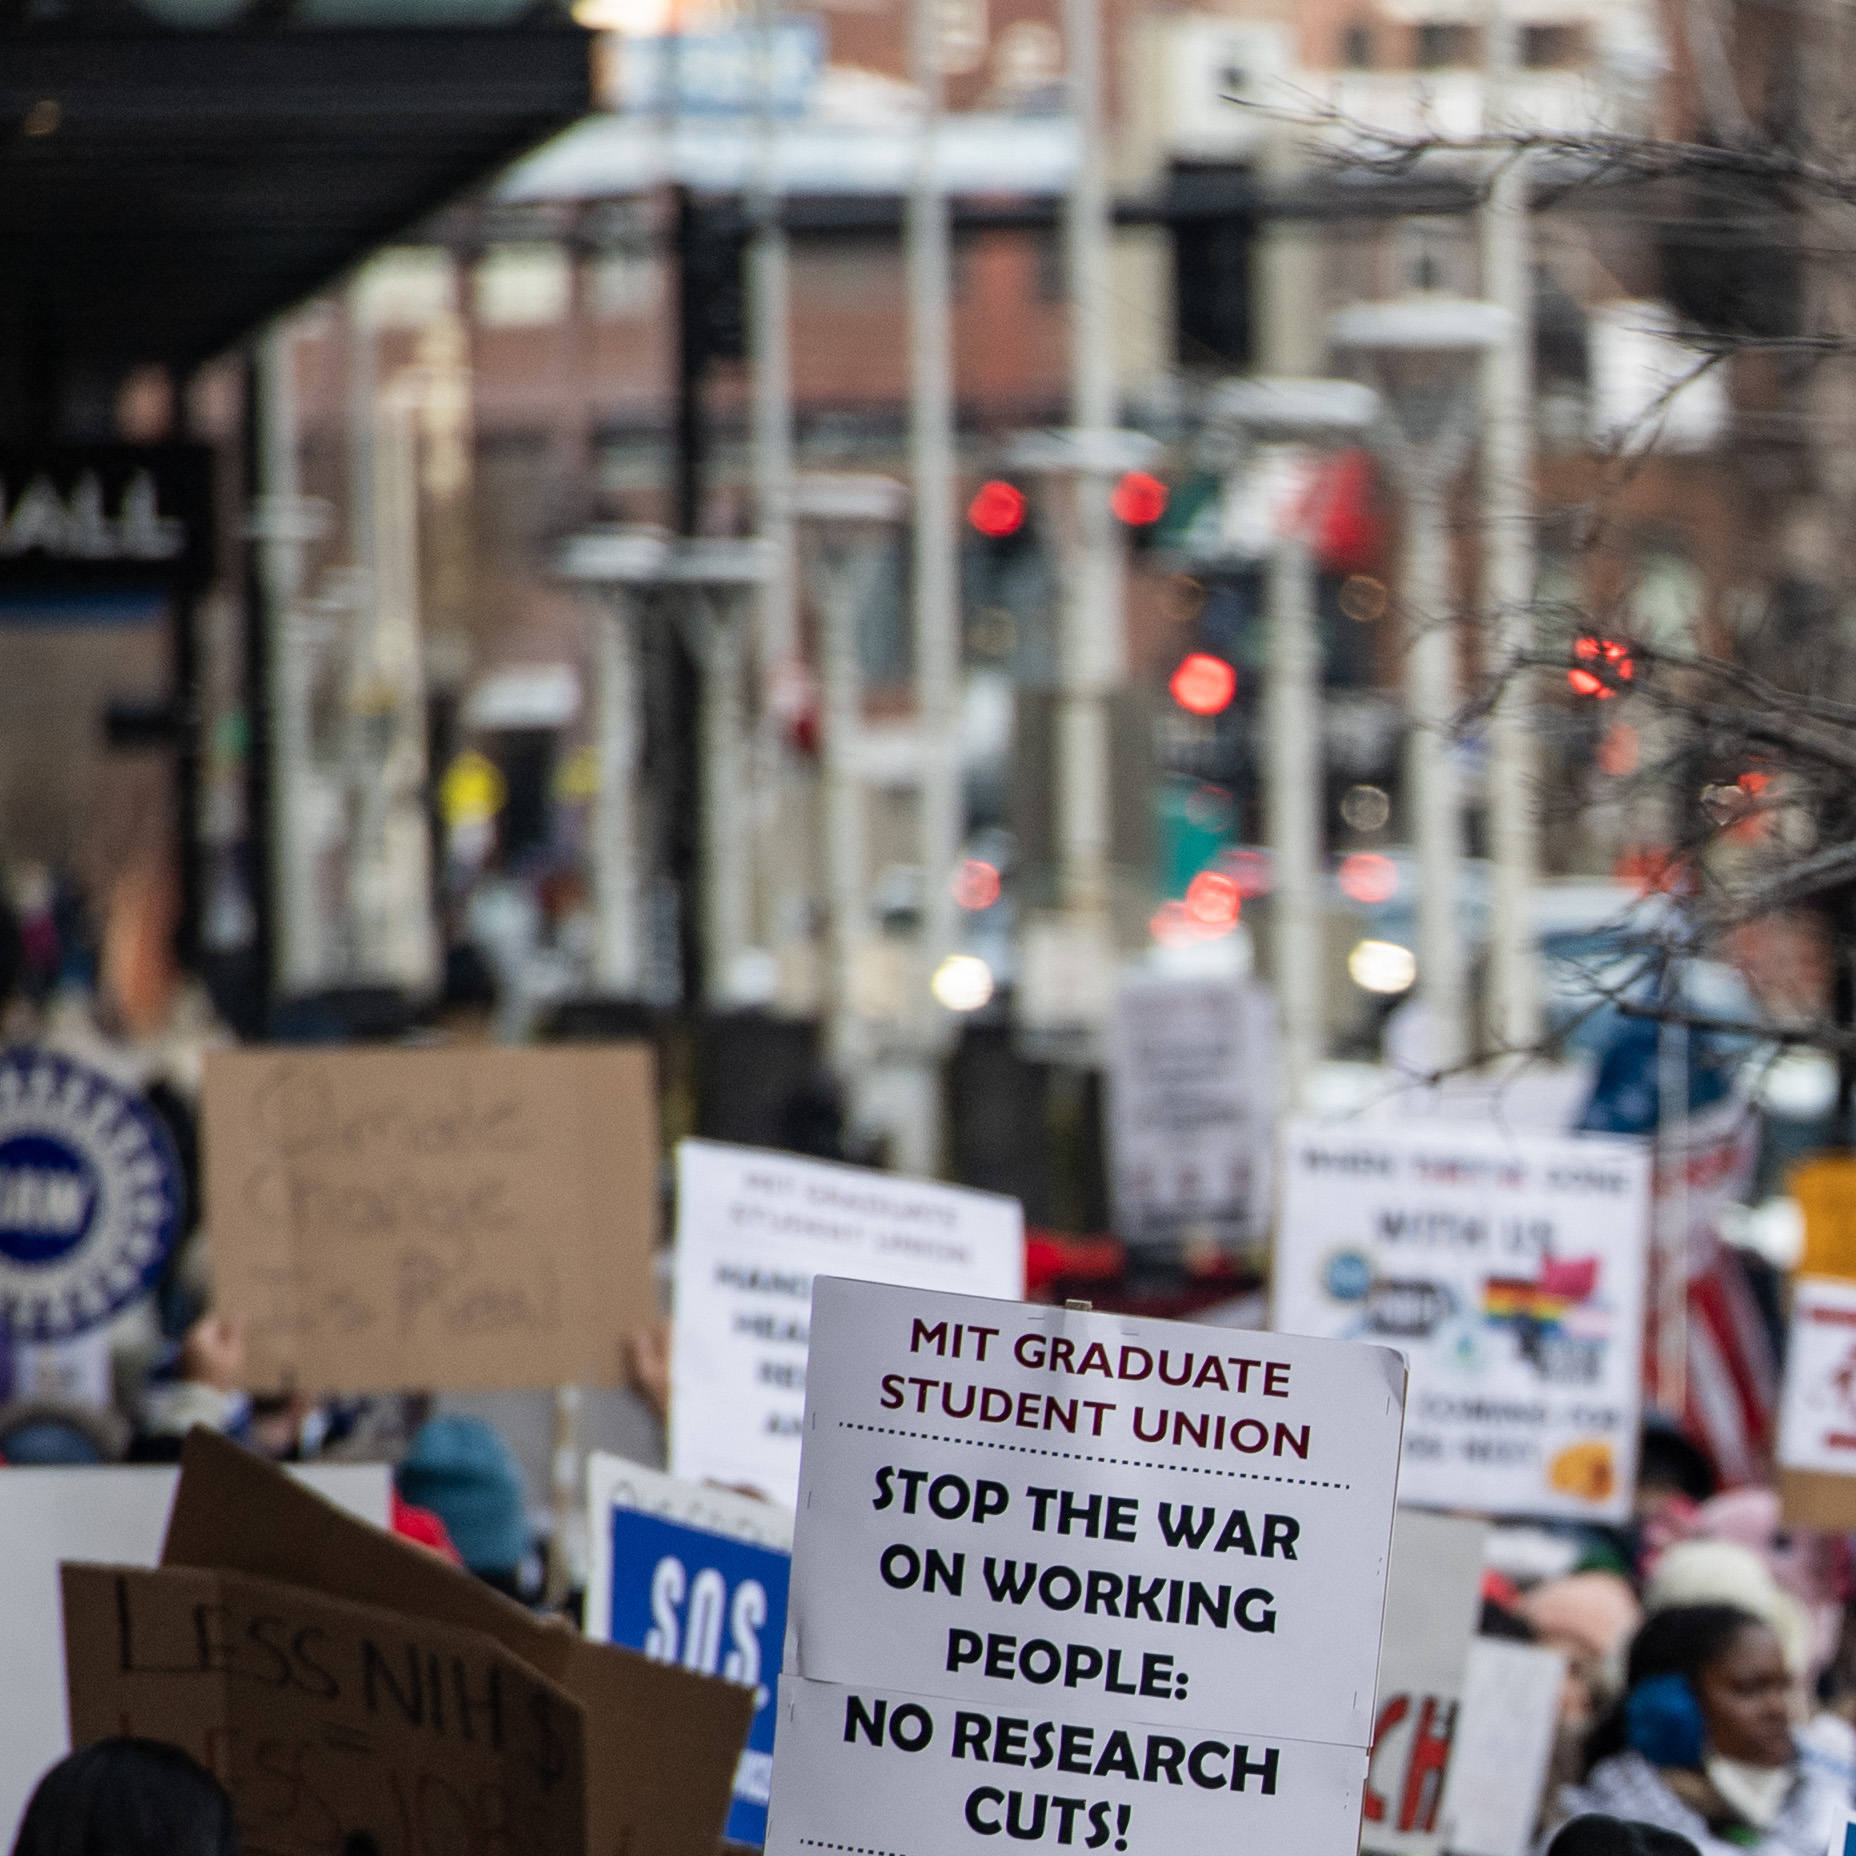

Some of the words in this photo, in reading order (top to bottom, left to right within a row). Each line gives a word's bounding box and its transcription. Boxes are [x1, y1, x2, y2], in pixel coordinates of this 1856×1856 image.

[909, 1318, 999, 1362] MIT
[1014, 1333, 1292, 1398] GRADUATE
[879, 1374, 1117, 1436] STUDENT
[1132, 1405, 1312, 1459] UNION
[871, 1465, 1010, 1524] STOP
[1025, 1486, 1139, 1543] THE
[1156, 1502, 1302, 1560] WAR
[879, 1543, 966, 1597] ON
[982, 1556, 1278, 1634] WORKING
[945, 1627, 1191, 1701] PEOPLE:
[842, 1694, 934, 1753] NO
[950, 1709, 1281, 1796] RESEARCH
[964, 1785, 1133, 1852] CUTS!
